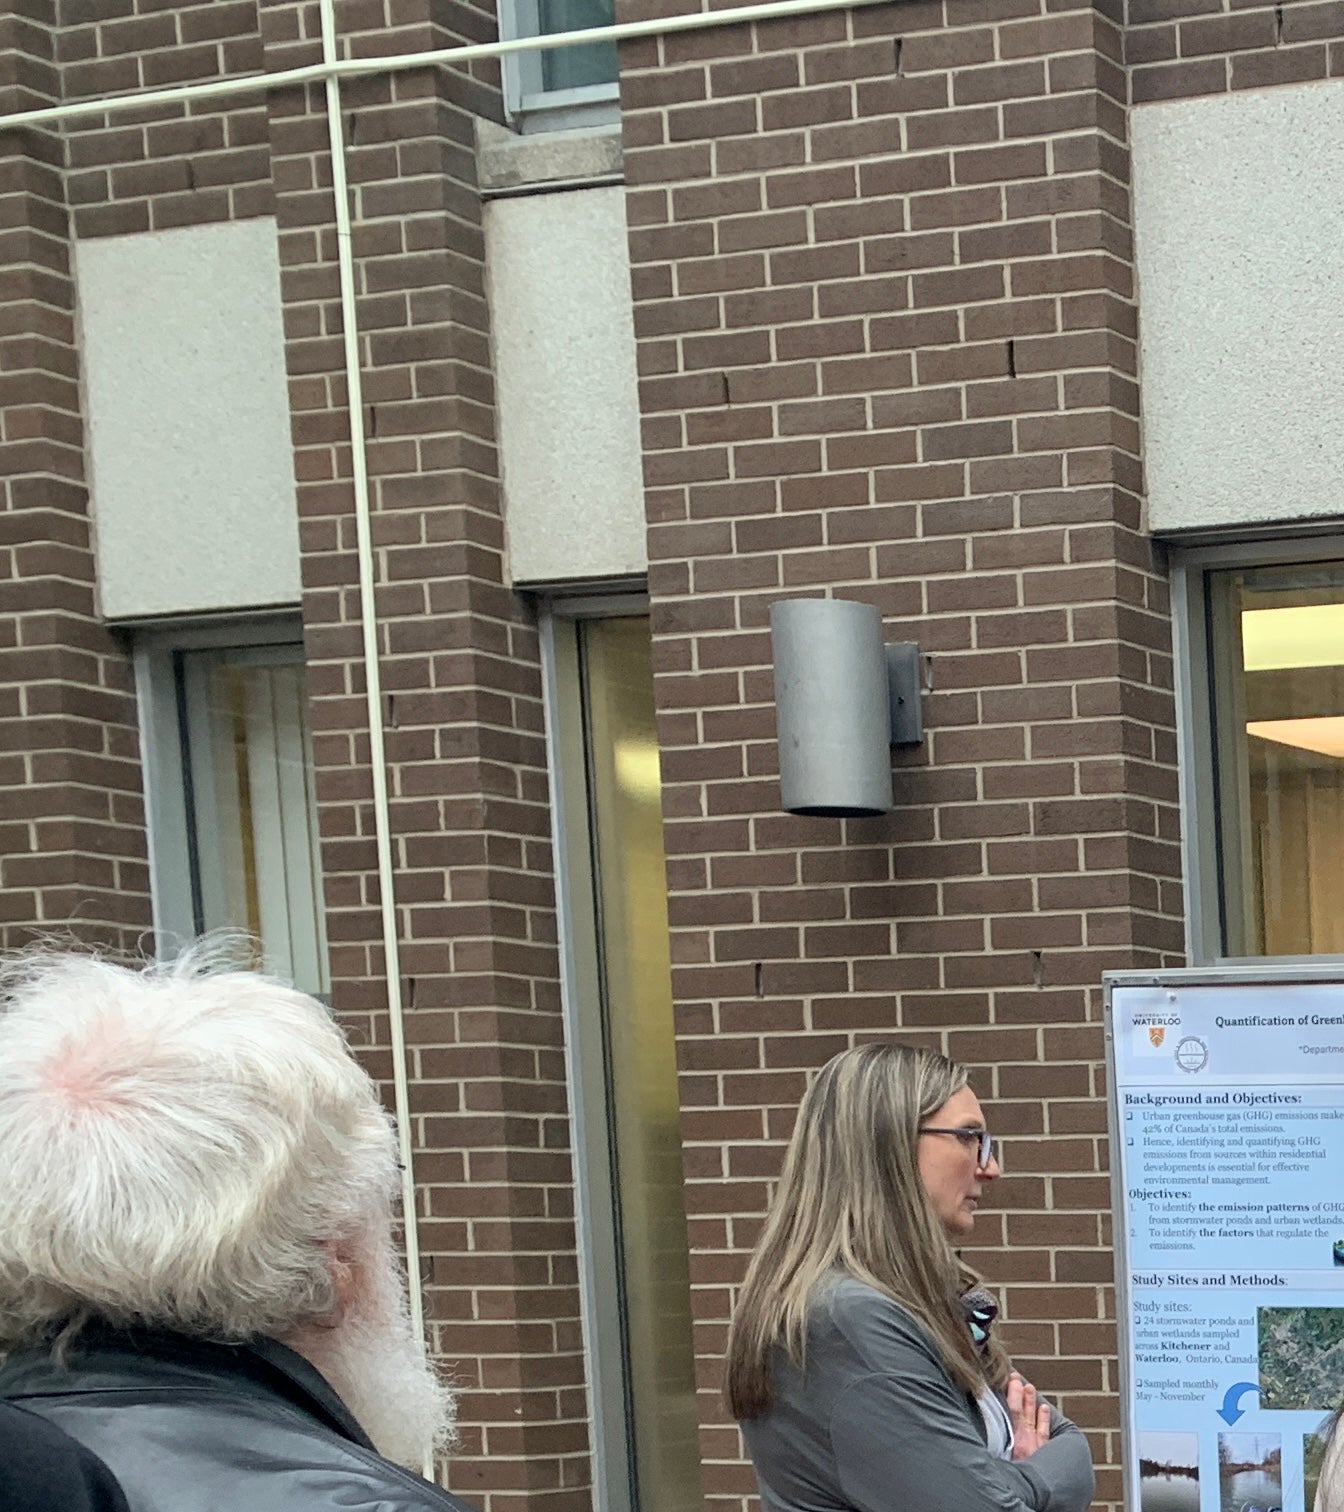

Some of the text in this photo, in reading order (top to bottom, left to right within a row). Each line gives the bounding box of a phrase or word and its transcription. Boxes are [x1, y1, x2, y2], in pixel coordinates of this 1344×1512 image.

[1132, 1018, 1181, 1026] WATERLOO
[1215, 1014, 1295, 1029] Quantification
[1297, 1013, 1309, 1025] of
[1124, 1091, 1303, 1107] Background and Objectives:
[1142, 1111, 1171, 1121] Urban
[1172, 1111, 1225, 1123] greenhouse
[1225, 1113, 1241, 1123] gas
[1242, 1111, 1273, 1122] (GHG)
[1274, 1110, 1319, 1120] emissions
[1320, 1110, 1344, 1120] make
[1128, 1188, 1192, 1201] Objectives:
[1149, 1202, 1160, 1212] To
[1161, 1202, 1196, 1214] identify
[1198, 1202, 1216, 1212] the
[1217, 1202, 1264, 1212] emission
[1265, 1202, 1310, 1214] patterns
[1311, 1202, 1321, 1212] of
[1149, 1228, 1330, 1239] To identify the factors that regulate the
[1132, 1274, 1289, 1287] Study Sites and Methods:
[1135, 1353, 1259, 1365] Waterloo, Ontario, Canada
